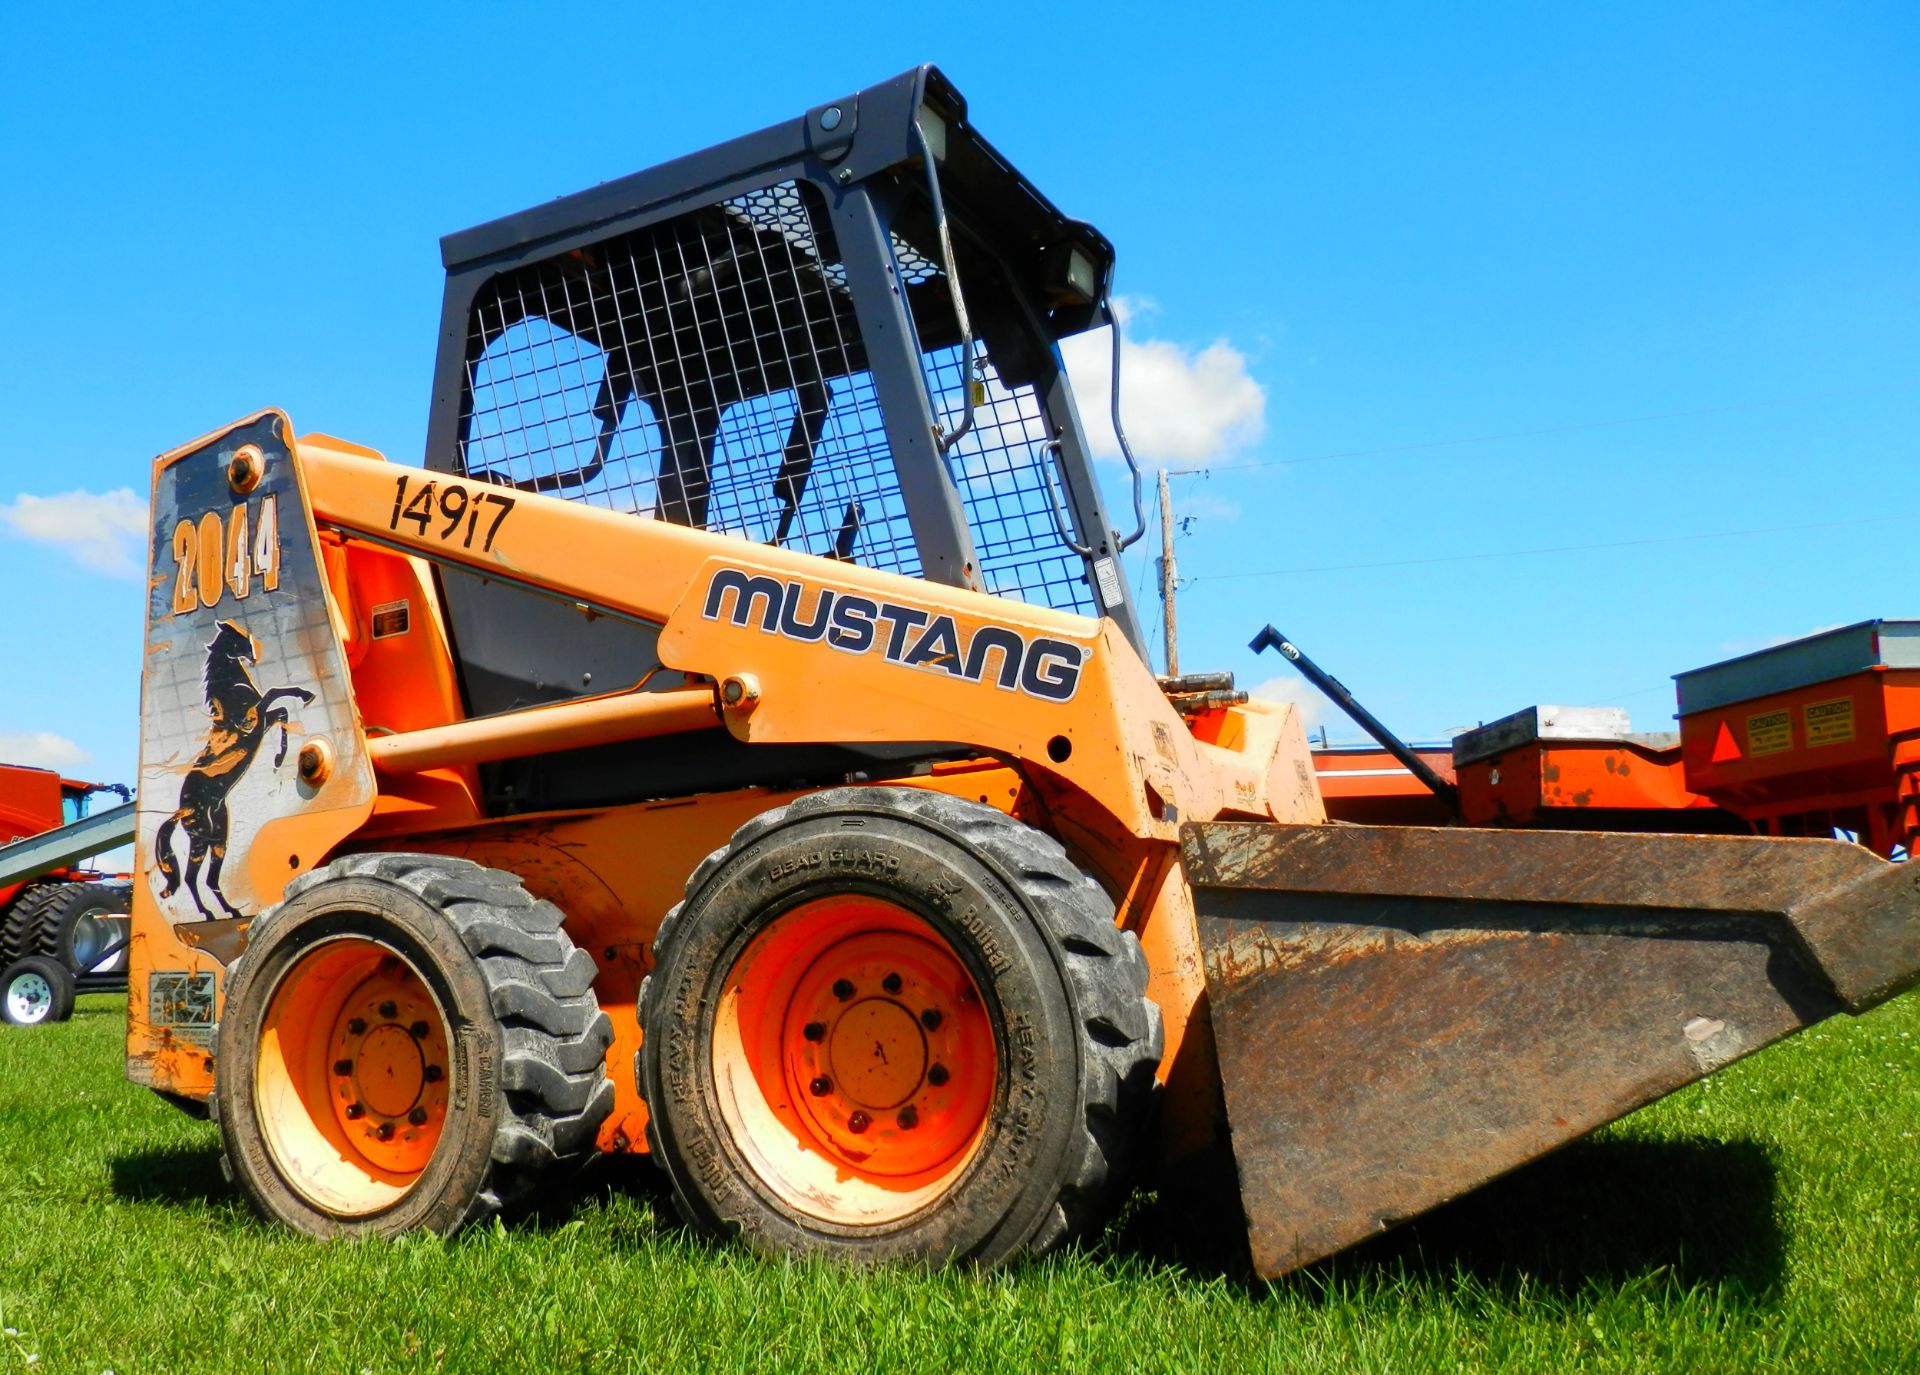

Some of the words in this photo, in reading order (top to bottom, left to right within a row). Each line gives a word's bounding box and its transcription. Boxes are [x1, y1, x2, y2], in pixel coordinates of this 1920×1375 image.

[172, 490, 281, 616] 2044
[390, 475, 516, 552] 14917
[702, 568, 1083, 701] MUSTANG
[1808, 702, 1850, 717] CAUTION
[769, 851, 822, 881] BEAD
[830, 848, 900, 875] GUARD
[1016, 1013, 1036, 1101] HEAVY
